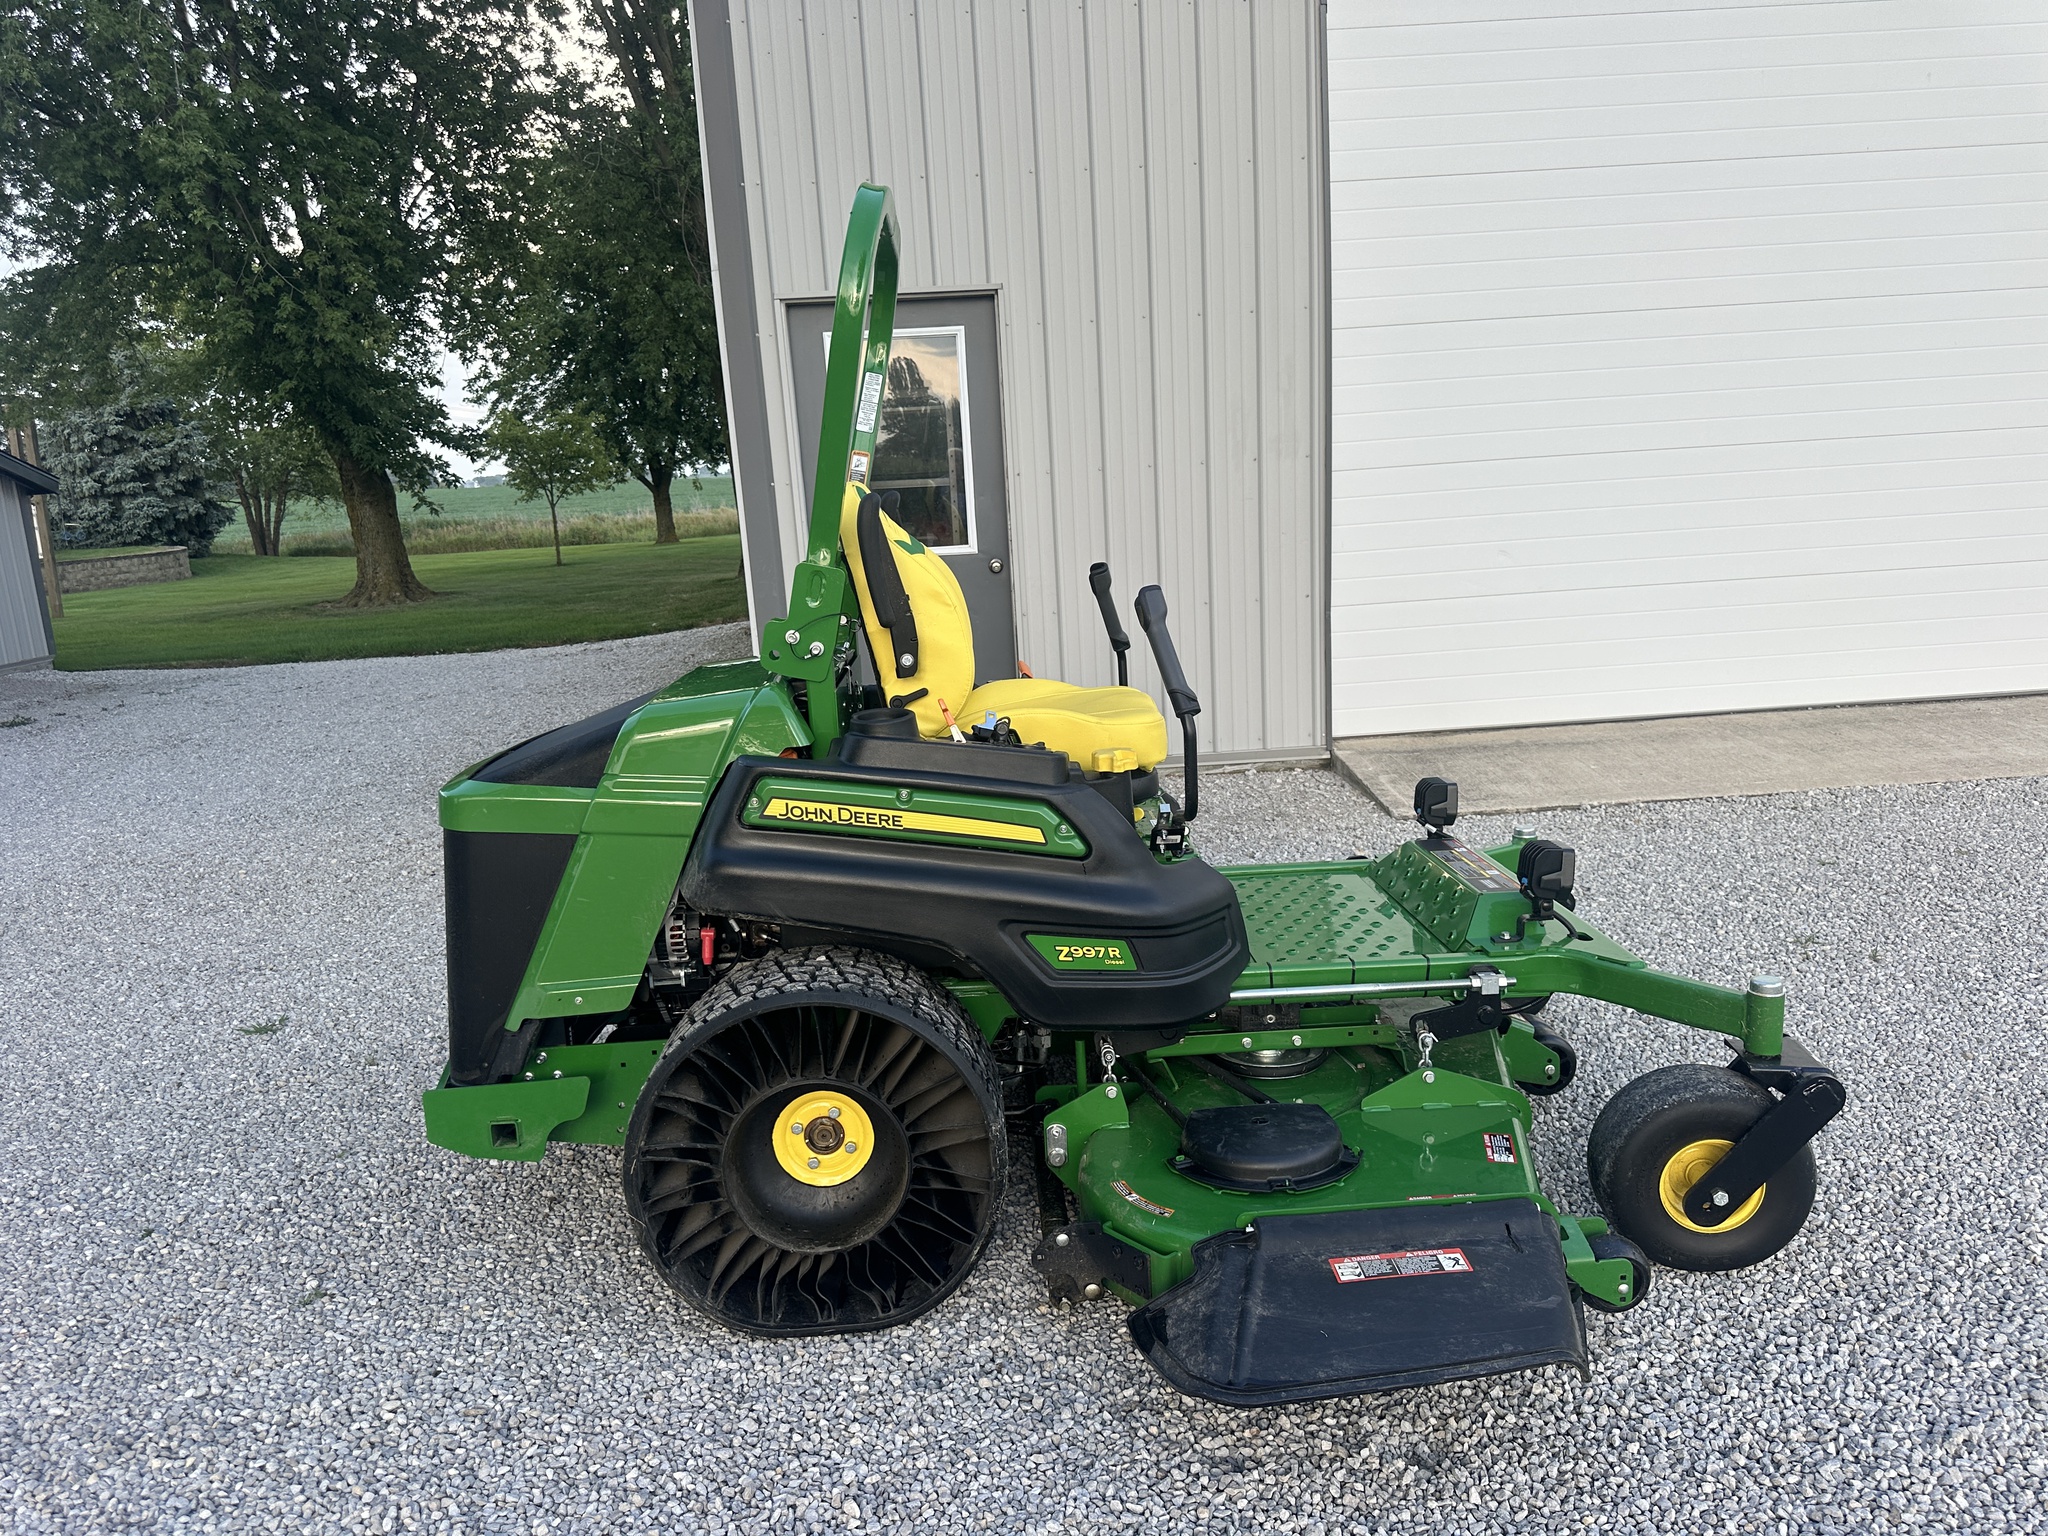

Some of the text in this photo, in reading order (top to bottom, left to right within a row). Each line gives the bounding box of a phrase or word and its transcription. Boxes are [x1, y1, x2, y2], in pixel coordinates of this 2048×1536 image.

[778, 802, 904, 828] JOHN DEERE
[1351, 1254, 1381, 1262] DANGER
